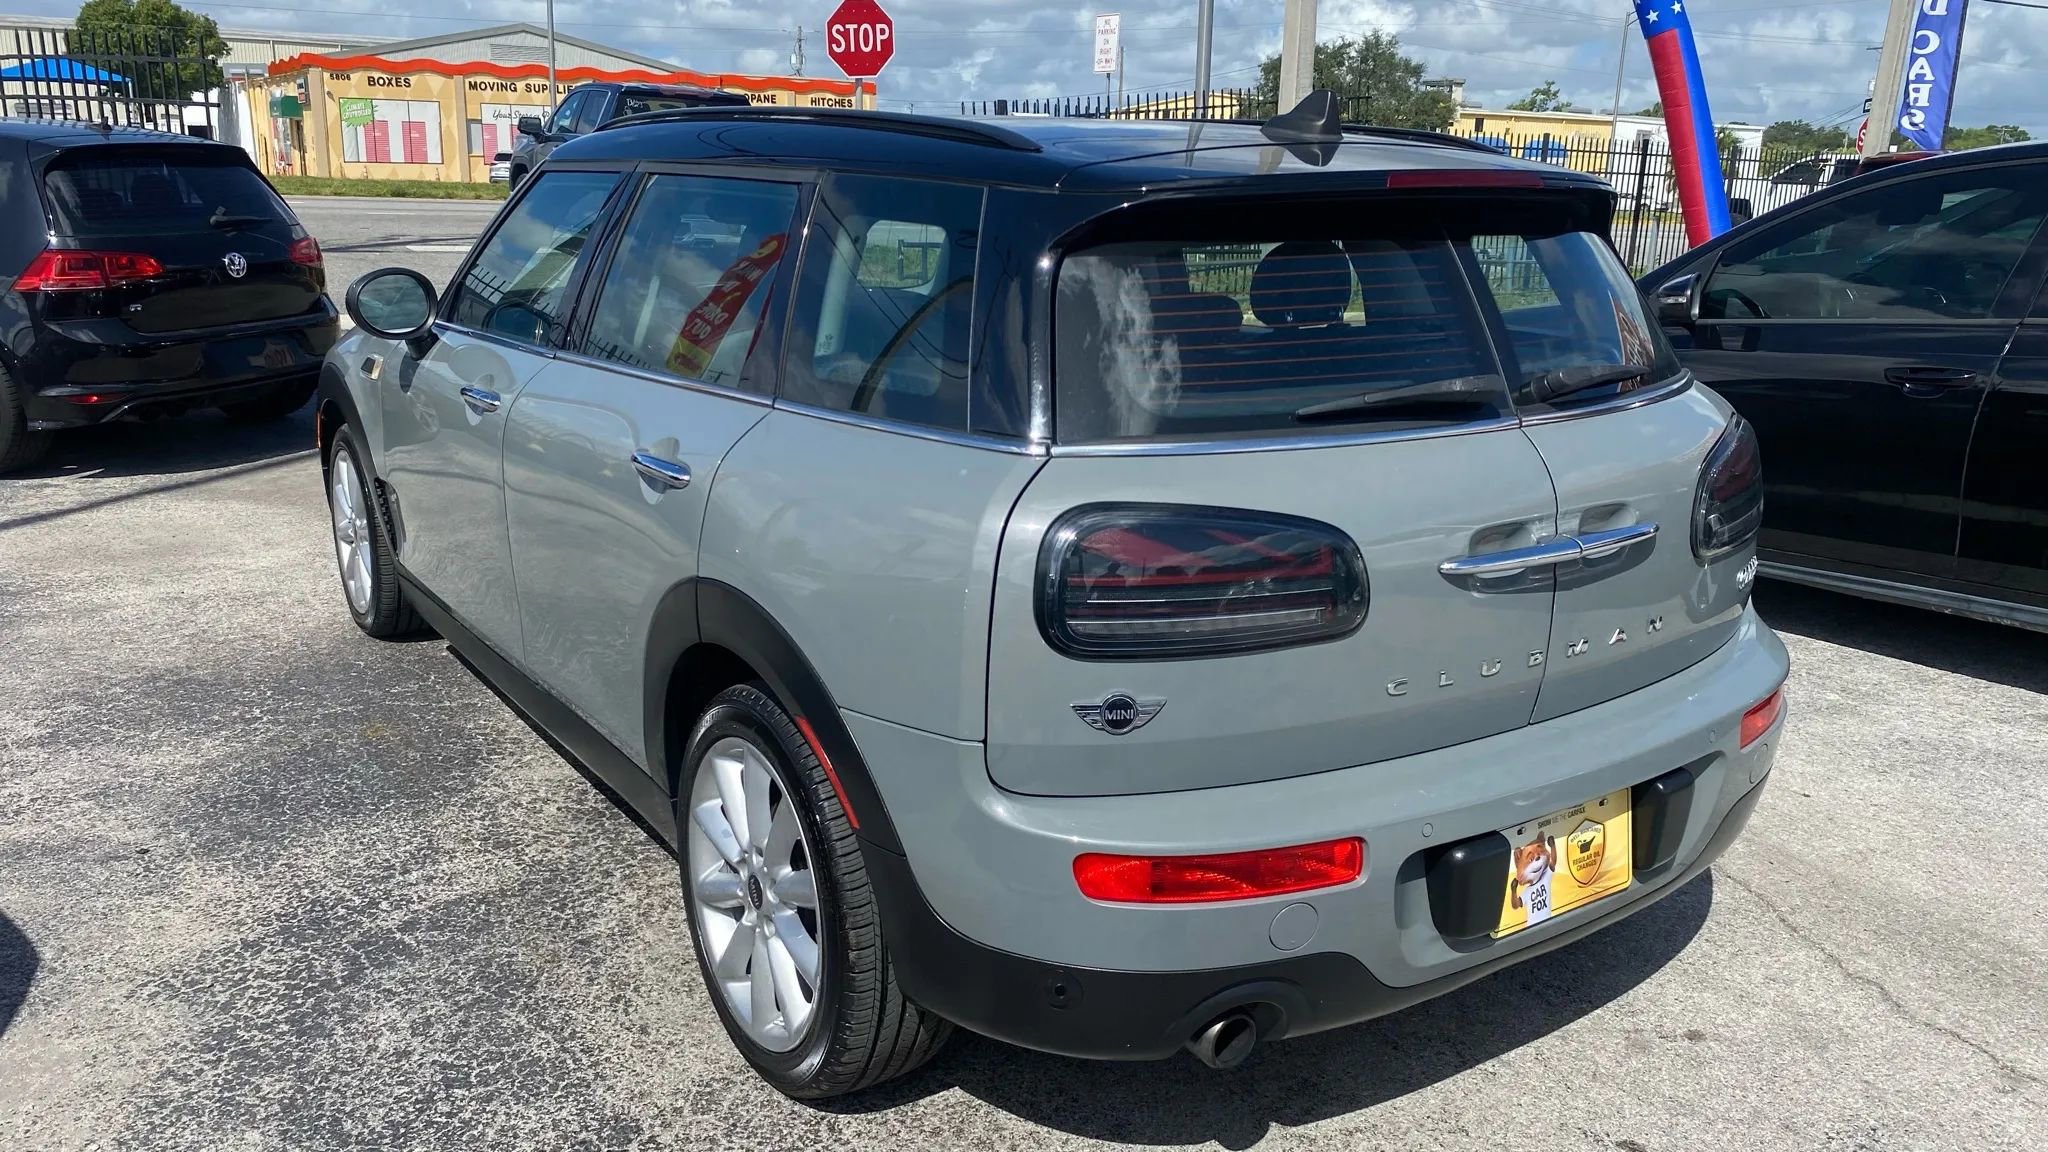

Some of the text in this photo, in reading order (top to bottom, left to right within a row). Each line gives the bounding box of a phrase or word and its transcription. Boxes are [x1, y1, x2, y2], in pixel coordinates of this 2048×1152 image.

[831, 23, 890, 53] STOP
[367, 76, 412, 88] BOXES
[468, 80, 518, 93] MOVING
[810, 97, 853, 108] HITCHES
[1386, 616, 1663, 696] CLUBMAN
[1105, 709, 1134, 720] MINI
[1567, 806, 1585, 818] CARFAX
[1572, 853, 1593, 866] REGULAR
[1576, 859, 1597, 871] CHANGES
[1531, 884, 1547, 902] CAR
[1531, 896, 1548, 914] FOX
